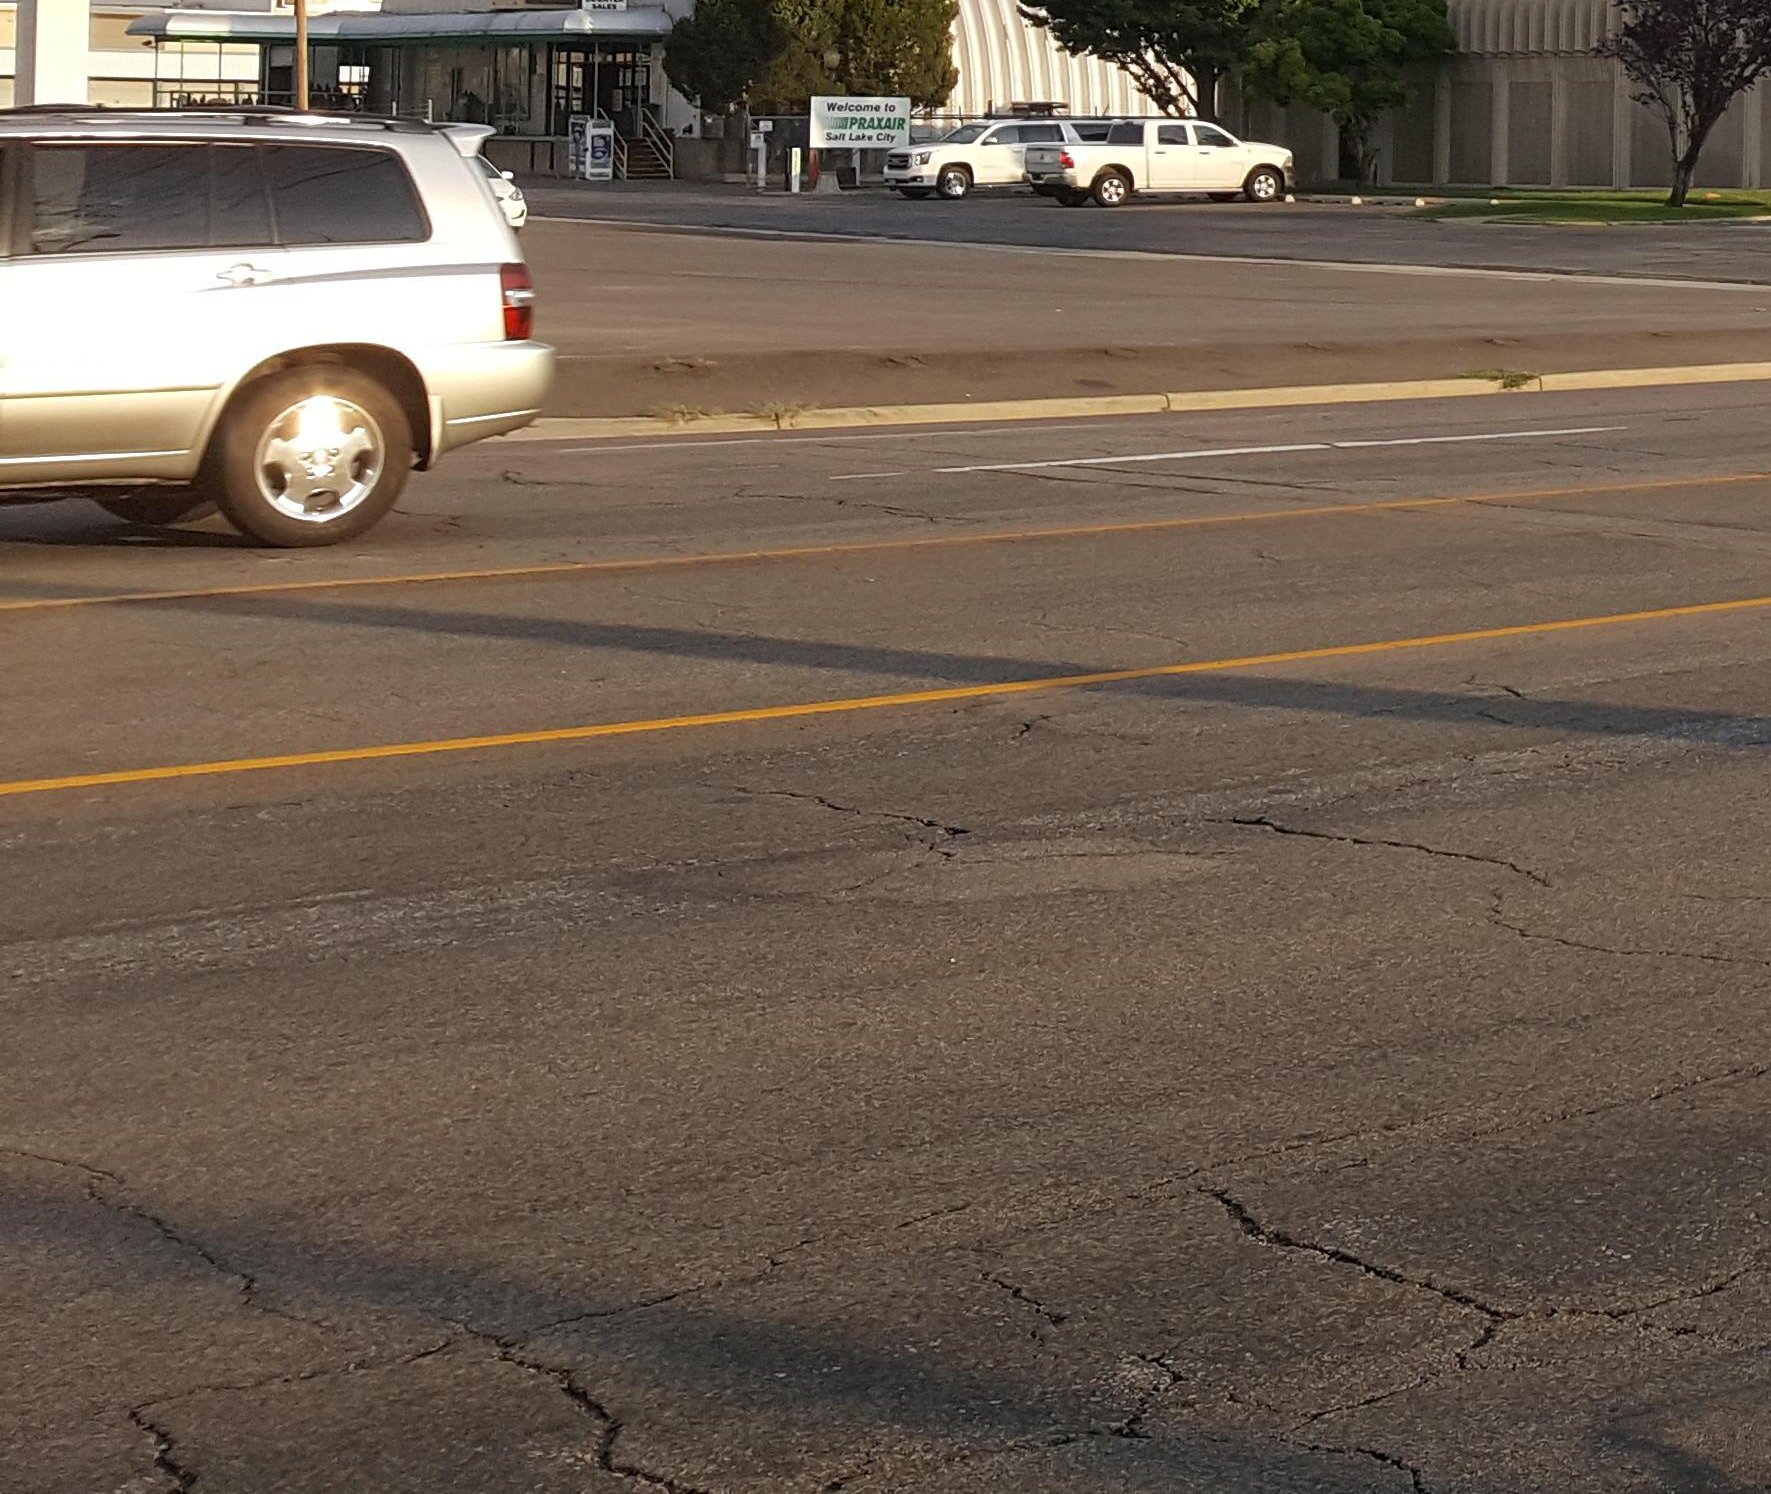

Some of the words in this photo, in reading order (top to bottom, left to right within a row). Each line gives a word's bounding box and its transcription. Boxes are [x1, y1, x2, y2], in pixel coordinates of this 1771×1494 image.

[826, 102, 881, 112] Welcome
[884, 102, 896, 112] to
[849, 117, 906, 130] PRAXAIR
[825, 132, 845, 141] Salt
[849, 133, 873, 141] Lake
[876, 133, 897, 143] City
